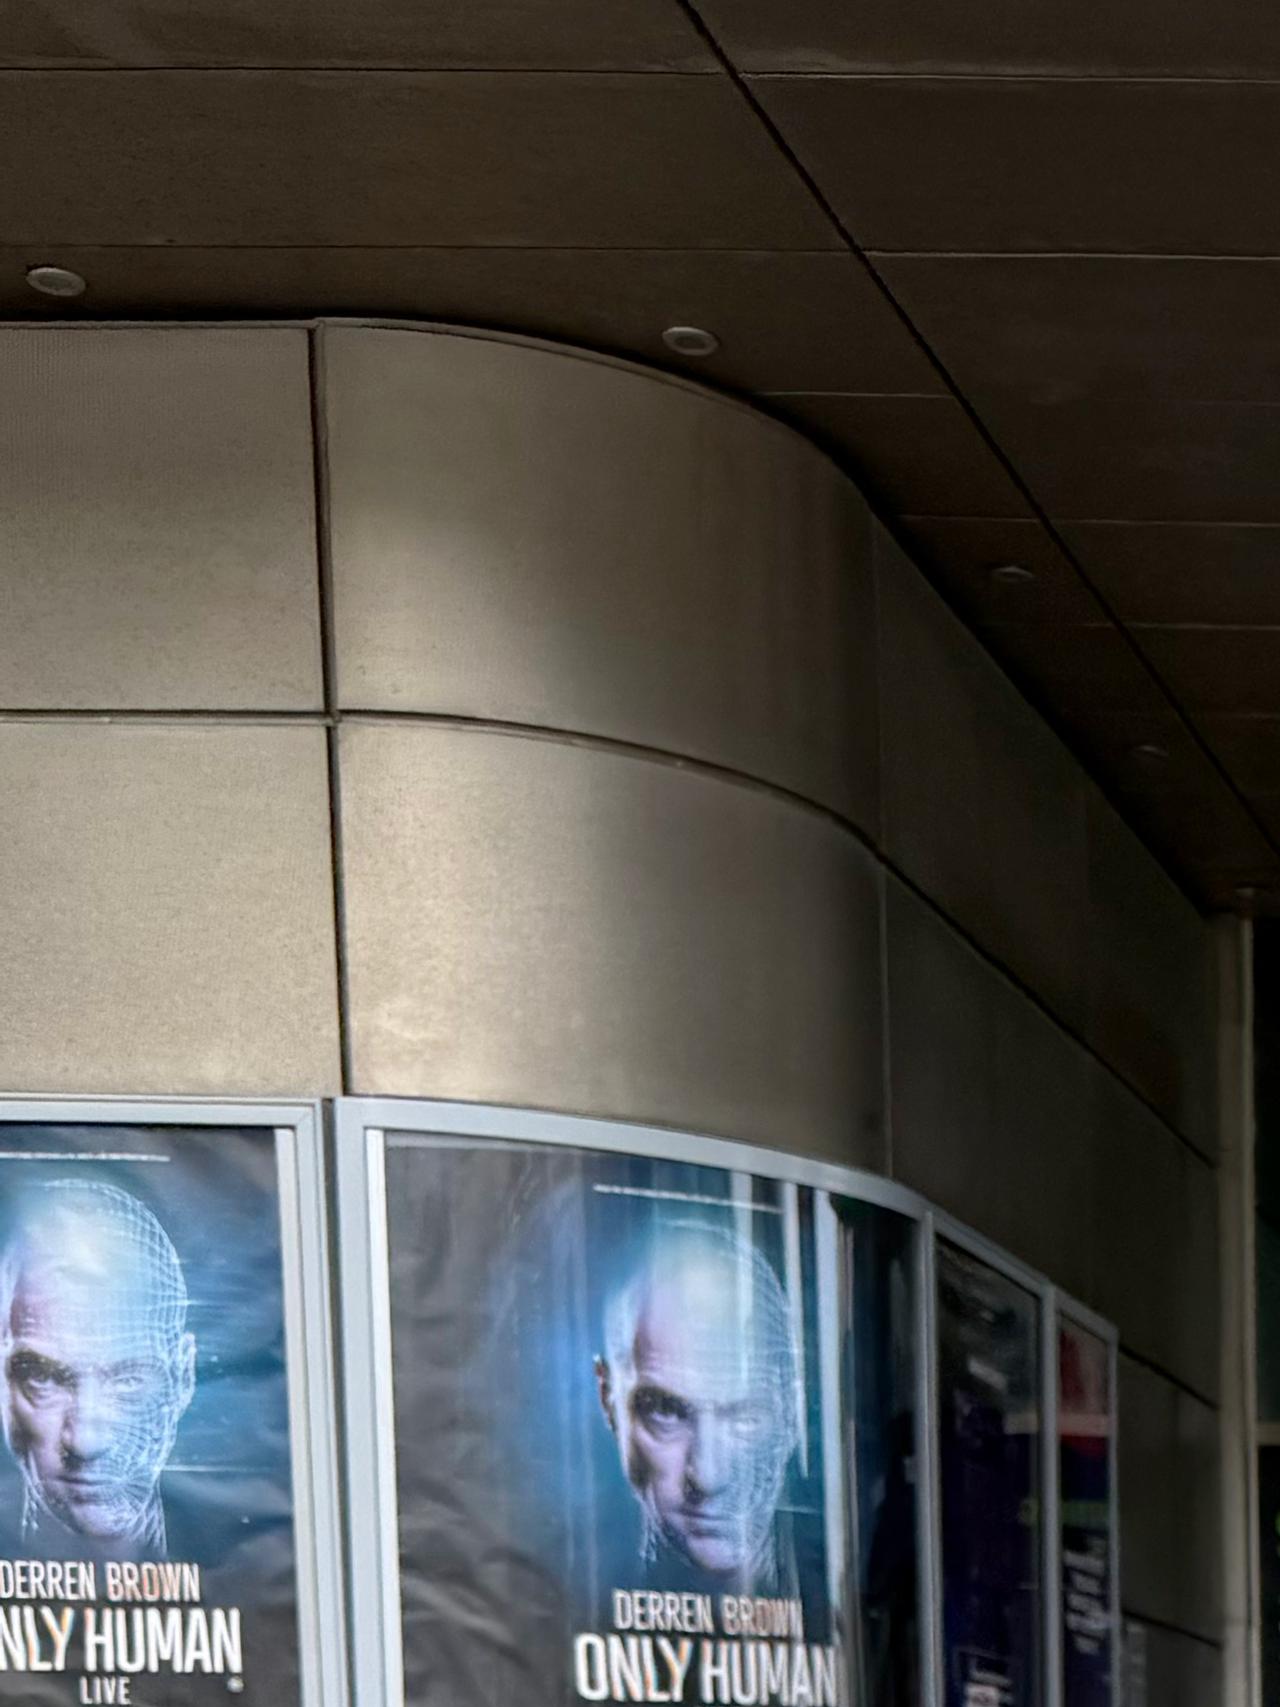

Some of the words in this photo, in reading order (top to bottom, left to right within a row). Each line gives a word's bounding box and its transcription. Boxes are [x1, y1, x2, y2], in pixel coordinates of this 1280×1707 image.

[0, 1559, 97, 1601] DERREN
[104, 1561, 201, 1602] BROWN
[613, 1588, 715, 1633] DERREN
[722, 1594, 804, 1640] BROWN
[79, 1675, 132, 1705] LIVE
[575, 1633, 693, 1702] ONLY
[700, 1638, 838, 1707] HUMAN
